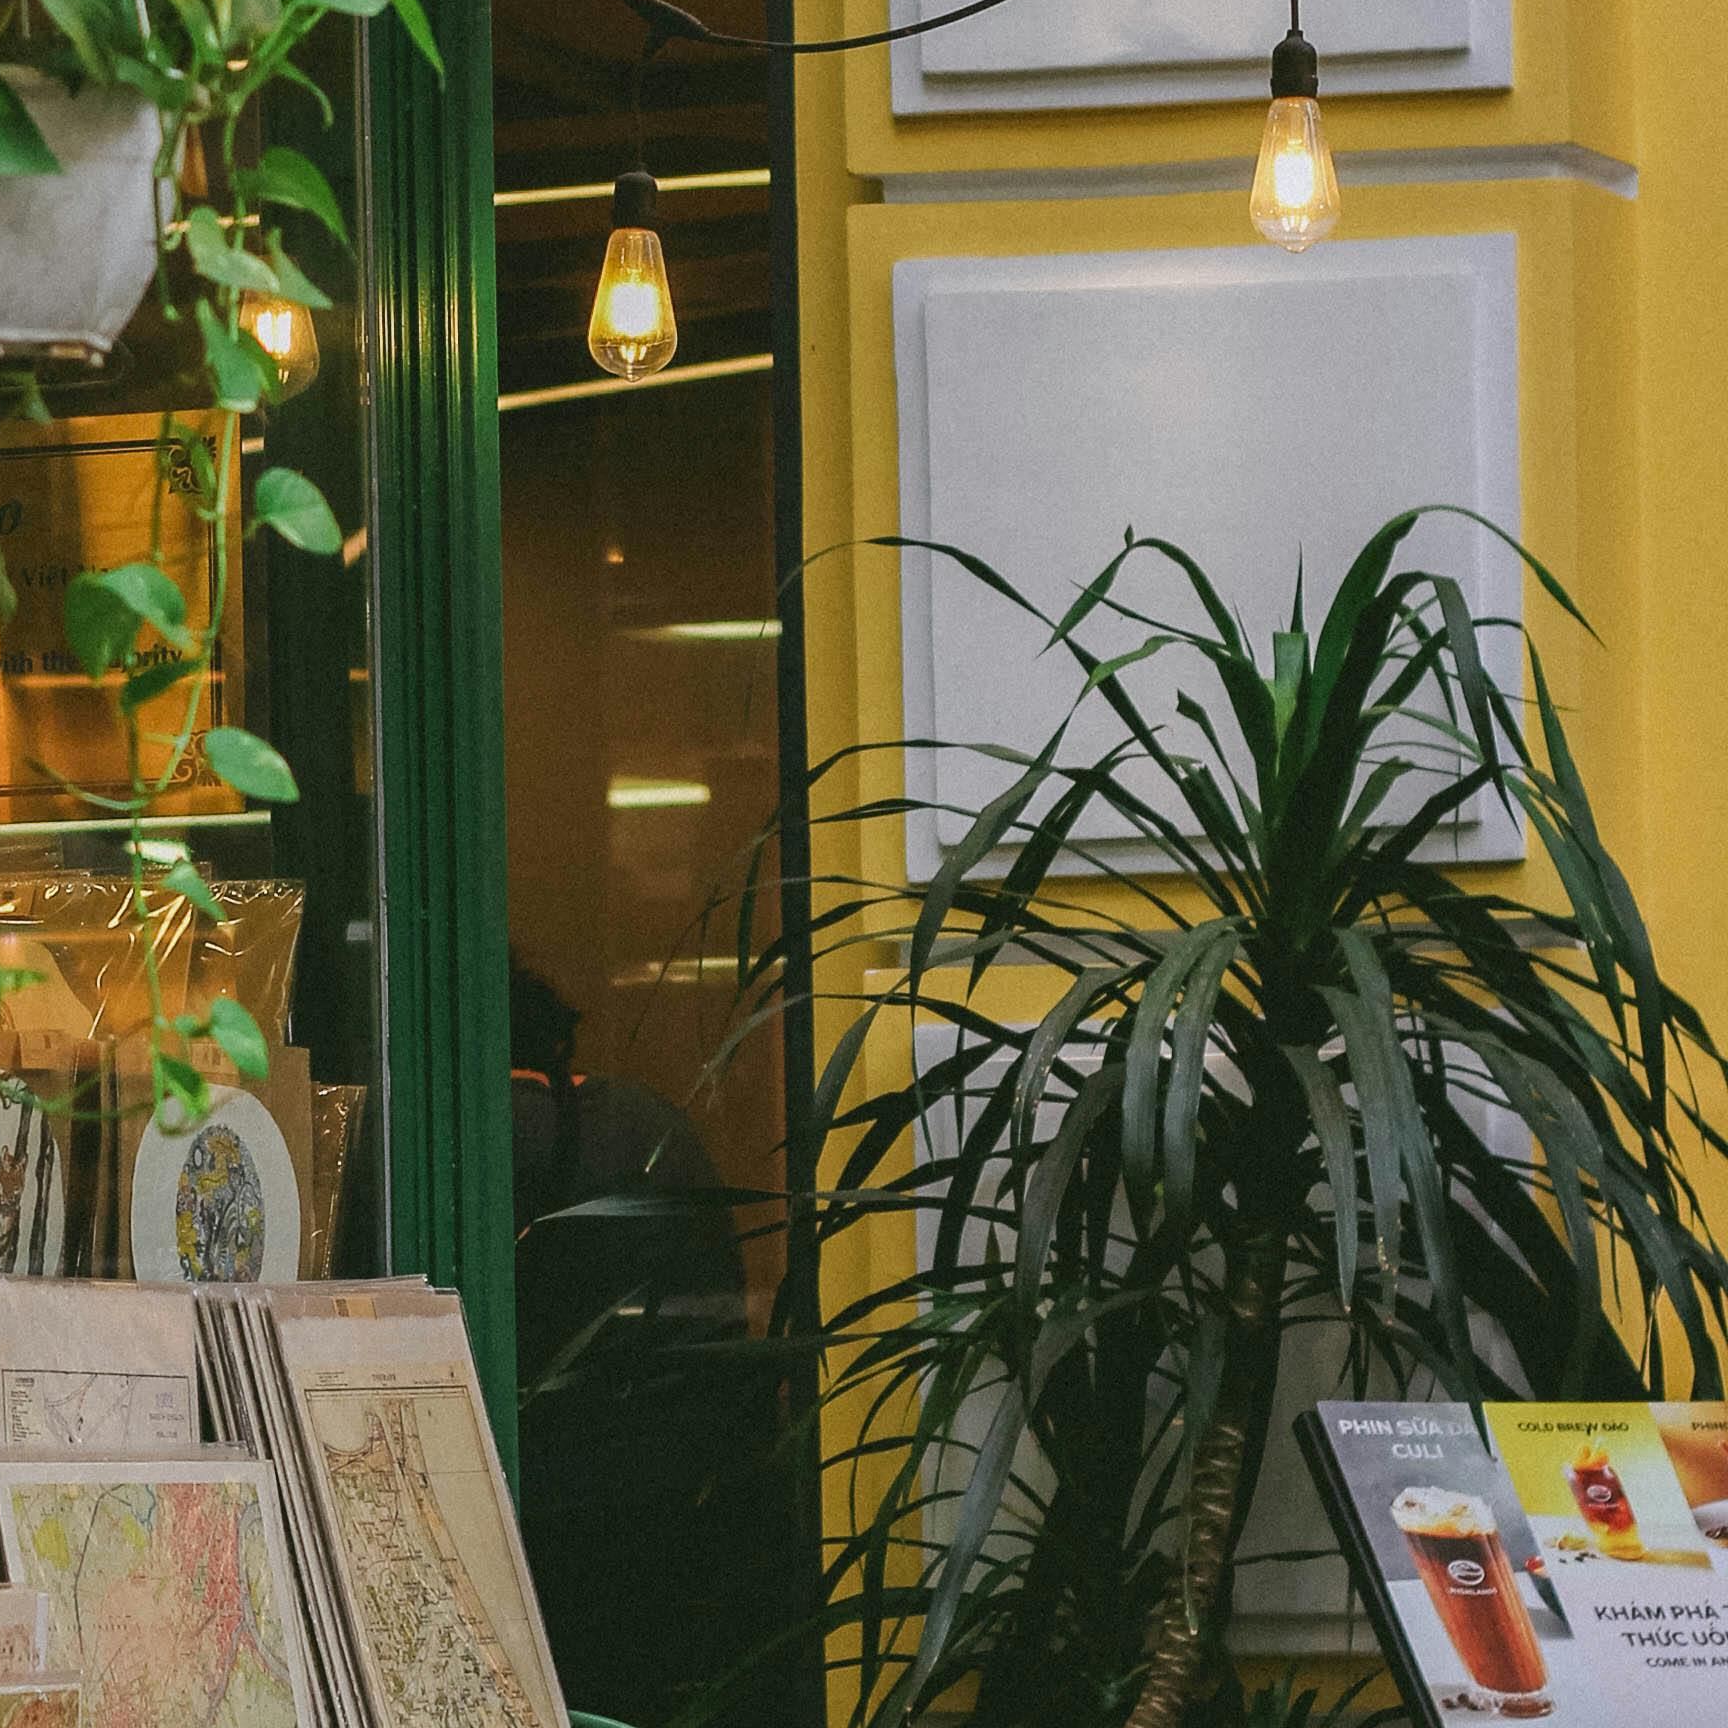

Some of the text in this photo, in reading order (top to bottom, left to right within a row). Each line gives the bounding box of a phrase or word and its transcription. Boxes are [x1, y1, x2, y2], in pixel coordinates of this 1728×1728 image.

[1338, 1419, 1393, 1436] PHIN
[1594, 1599, 1720, 1621] KHÁM PHÁ
